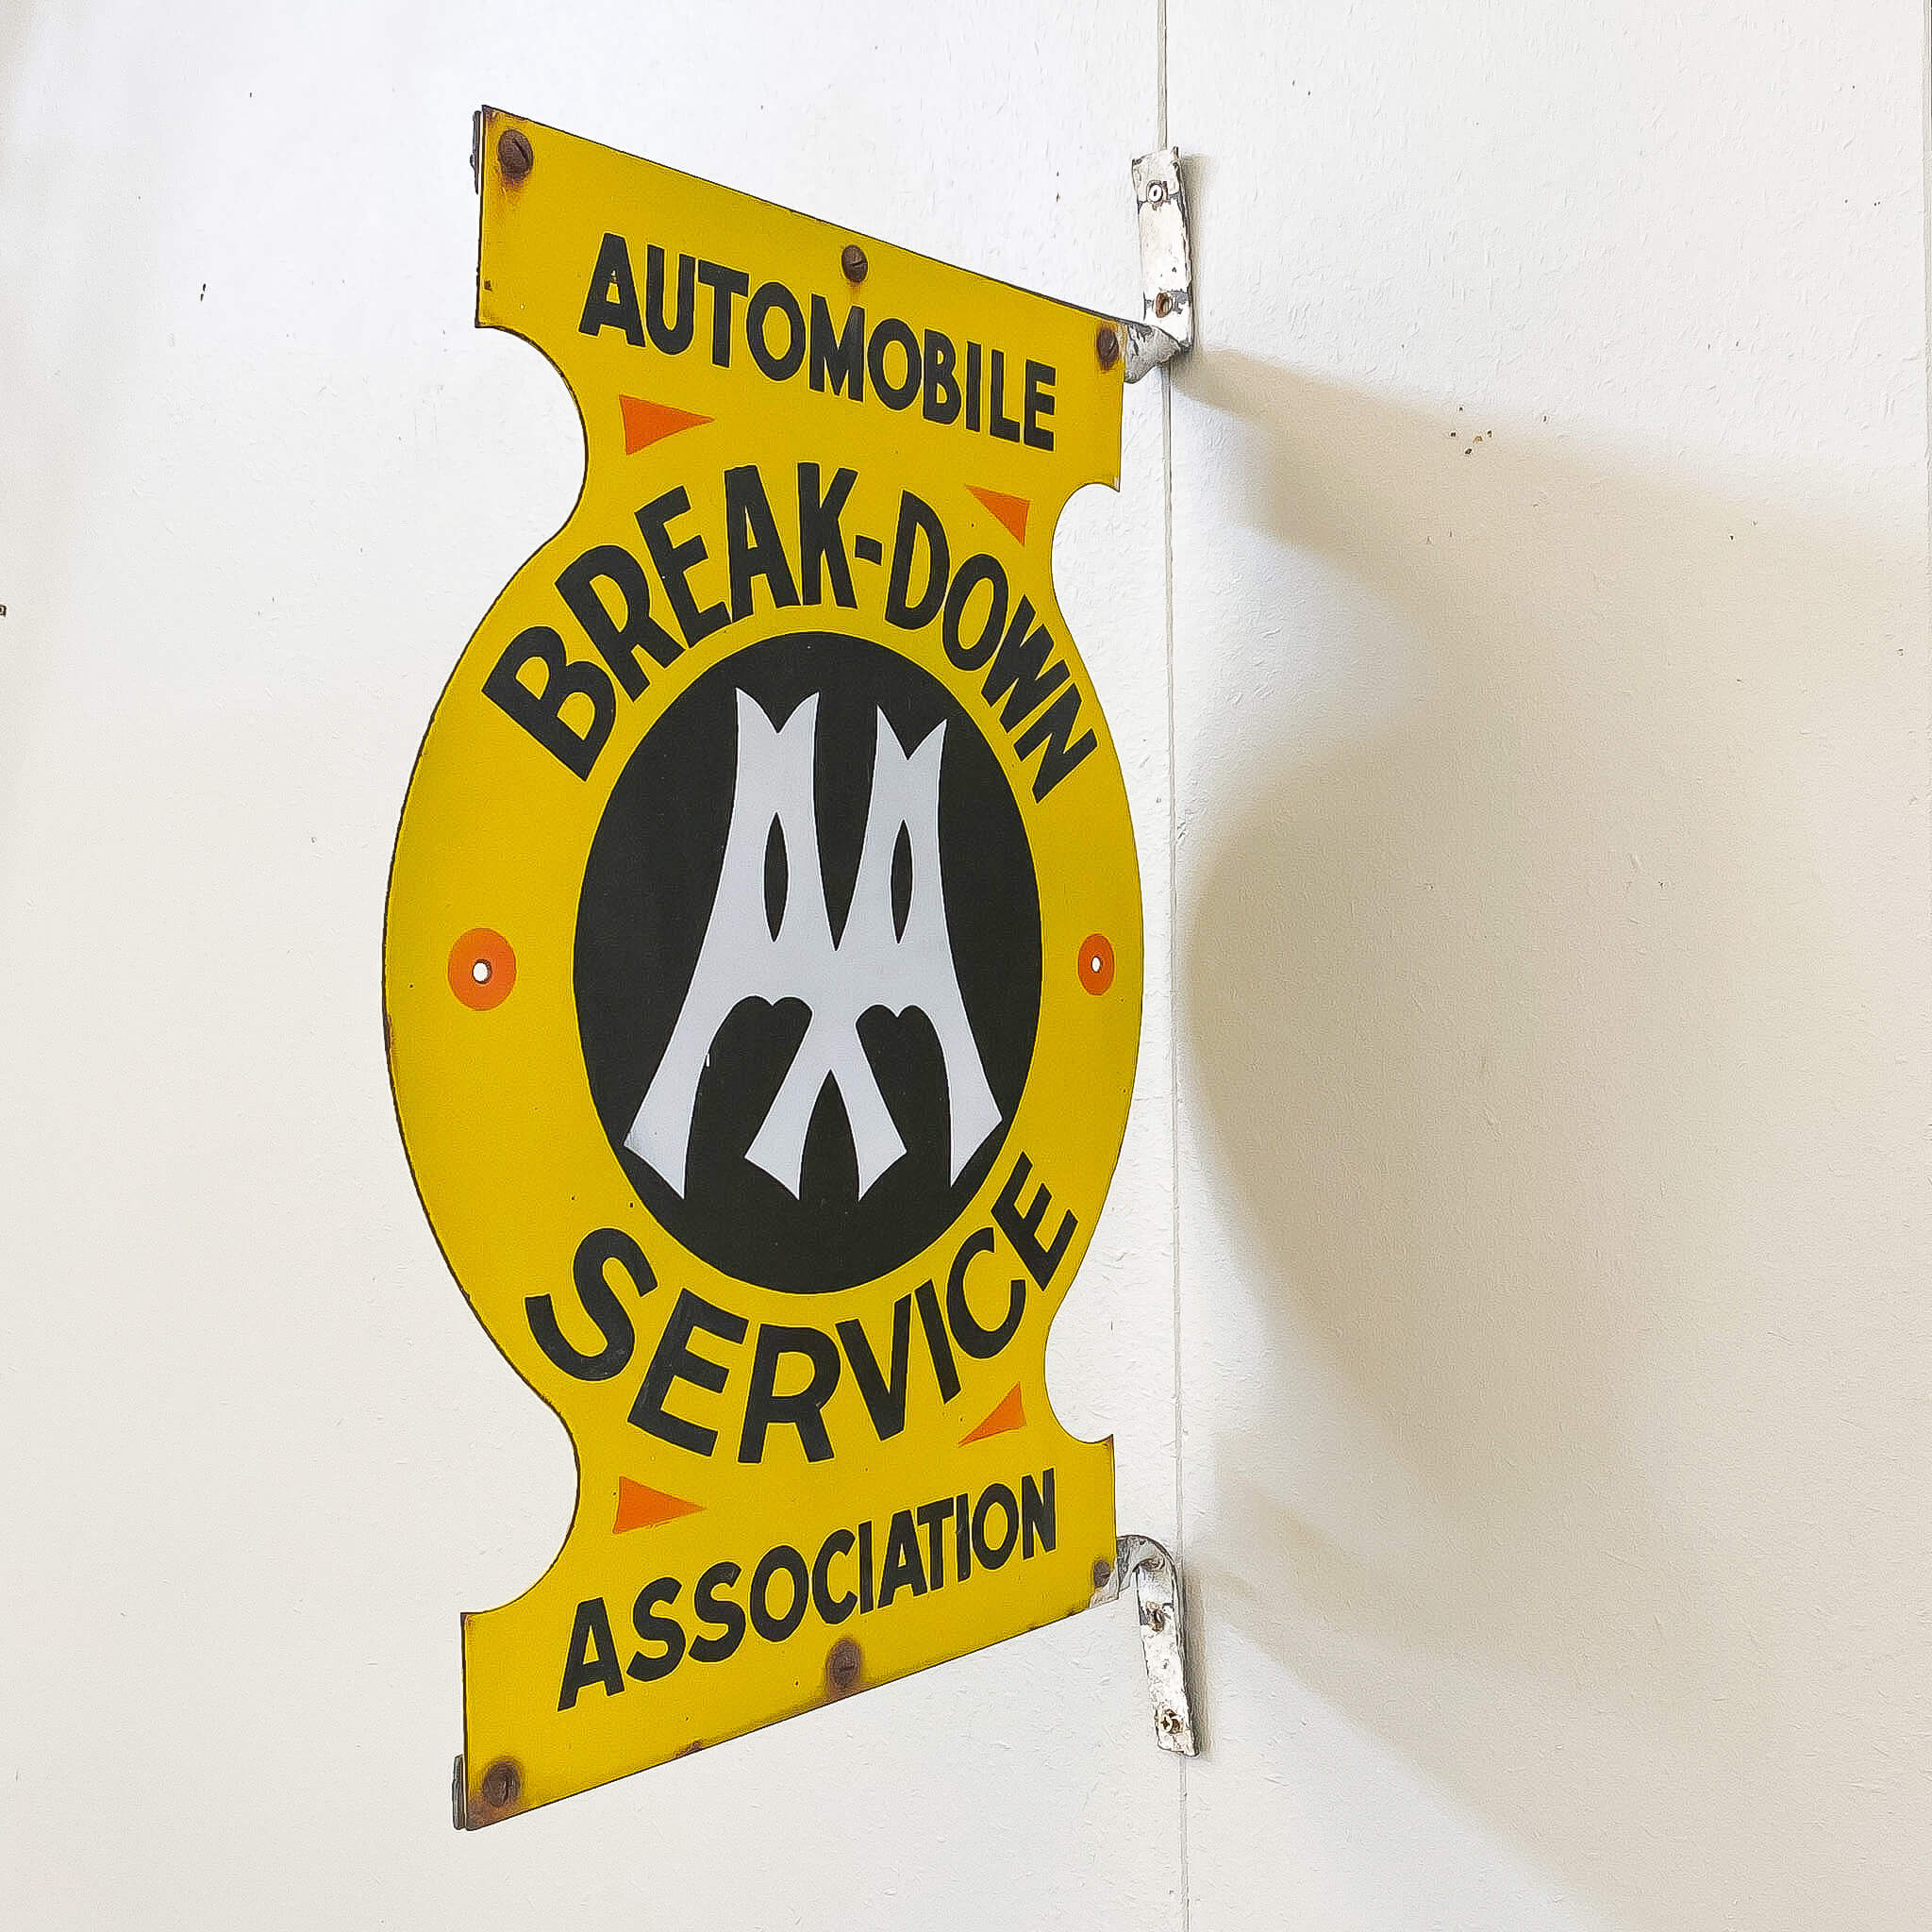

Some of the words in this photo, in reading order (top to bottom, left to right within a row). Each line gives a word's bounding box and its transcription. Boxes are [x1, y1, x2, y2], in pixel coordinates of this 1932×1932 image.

[579, 232, 1058, 451] AUTOMOBILE
[482, 461, 1098, 804] BREAK-DOWN
[525, 1151, 1079, 1464] SERVICE
[557, 1467, 1058, 1712] ASSOCIATION
